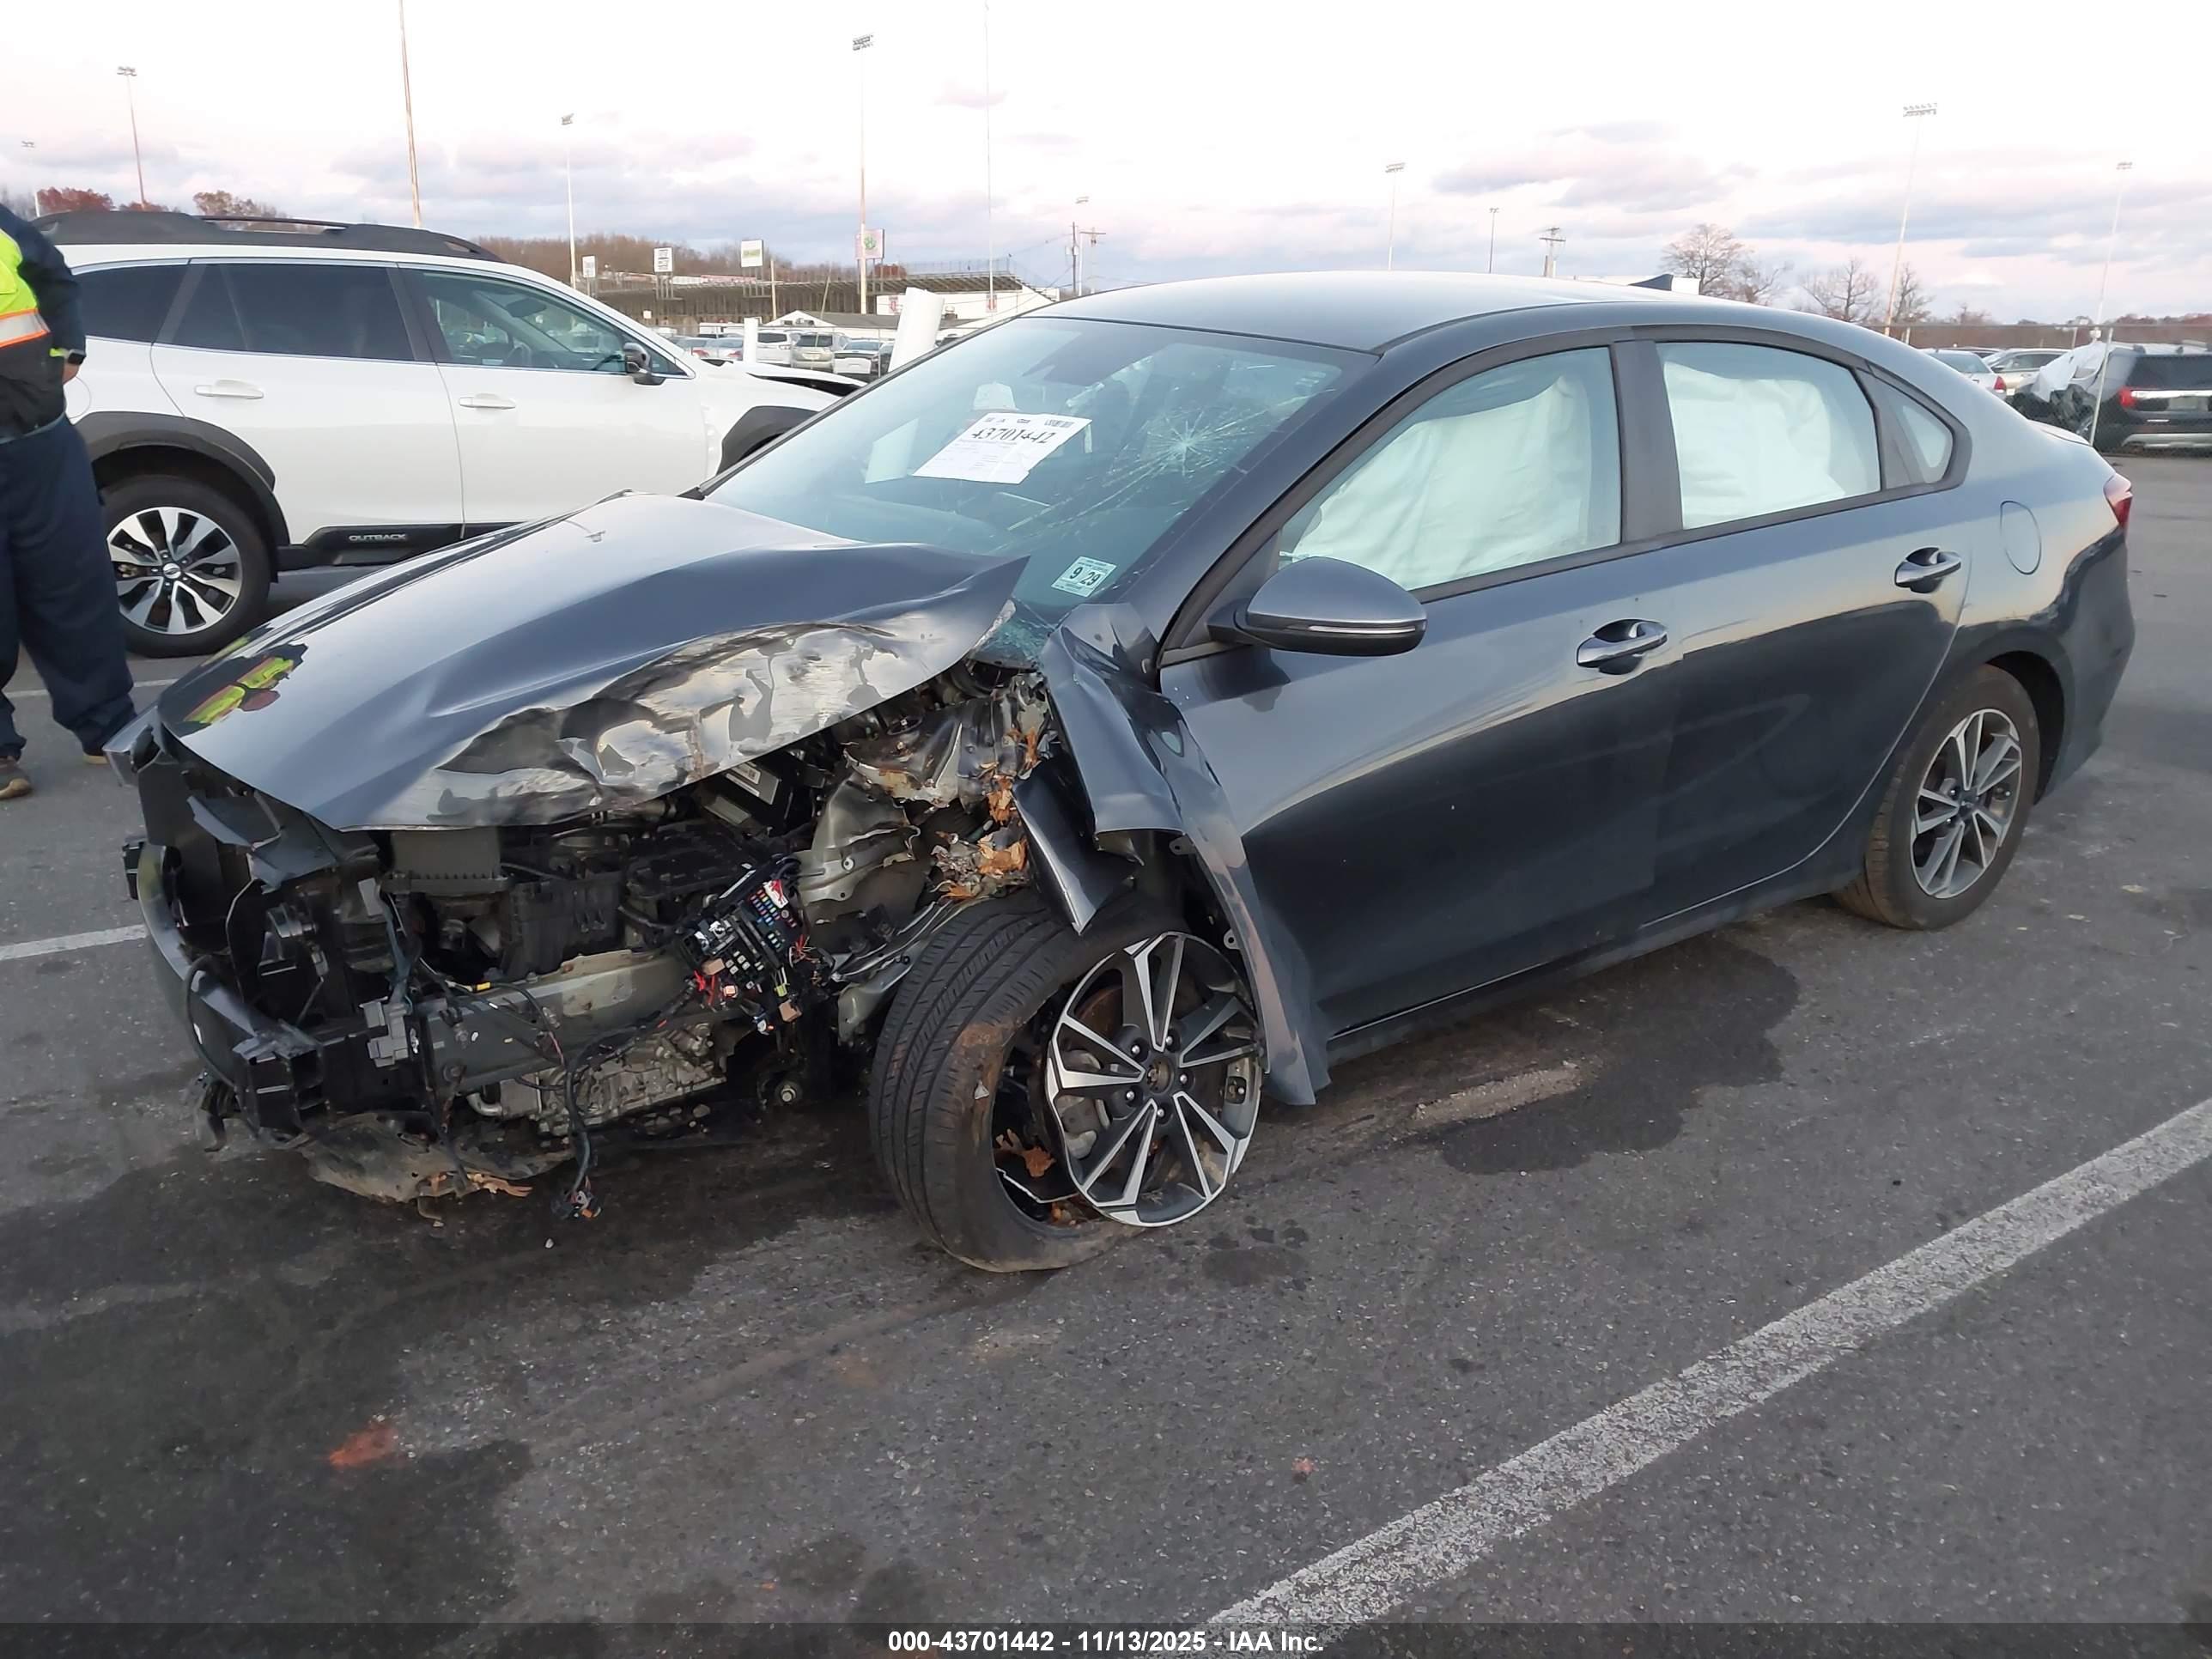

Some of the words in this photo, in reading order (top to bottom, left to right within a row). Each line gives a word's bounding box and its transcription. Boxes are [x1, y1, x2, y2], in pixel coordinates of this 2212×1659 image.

[349, 533, 406, 542] OUTBACK
[1069, 566, 1084, 580] 9
[1079, 571, 1101, 586] 29
